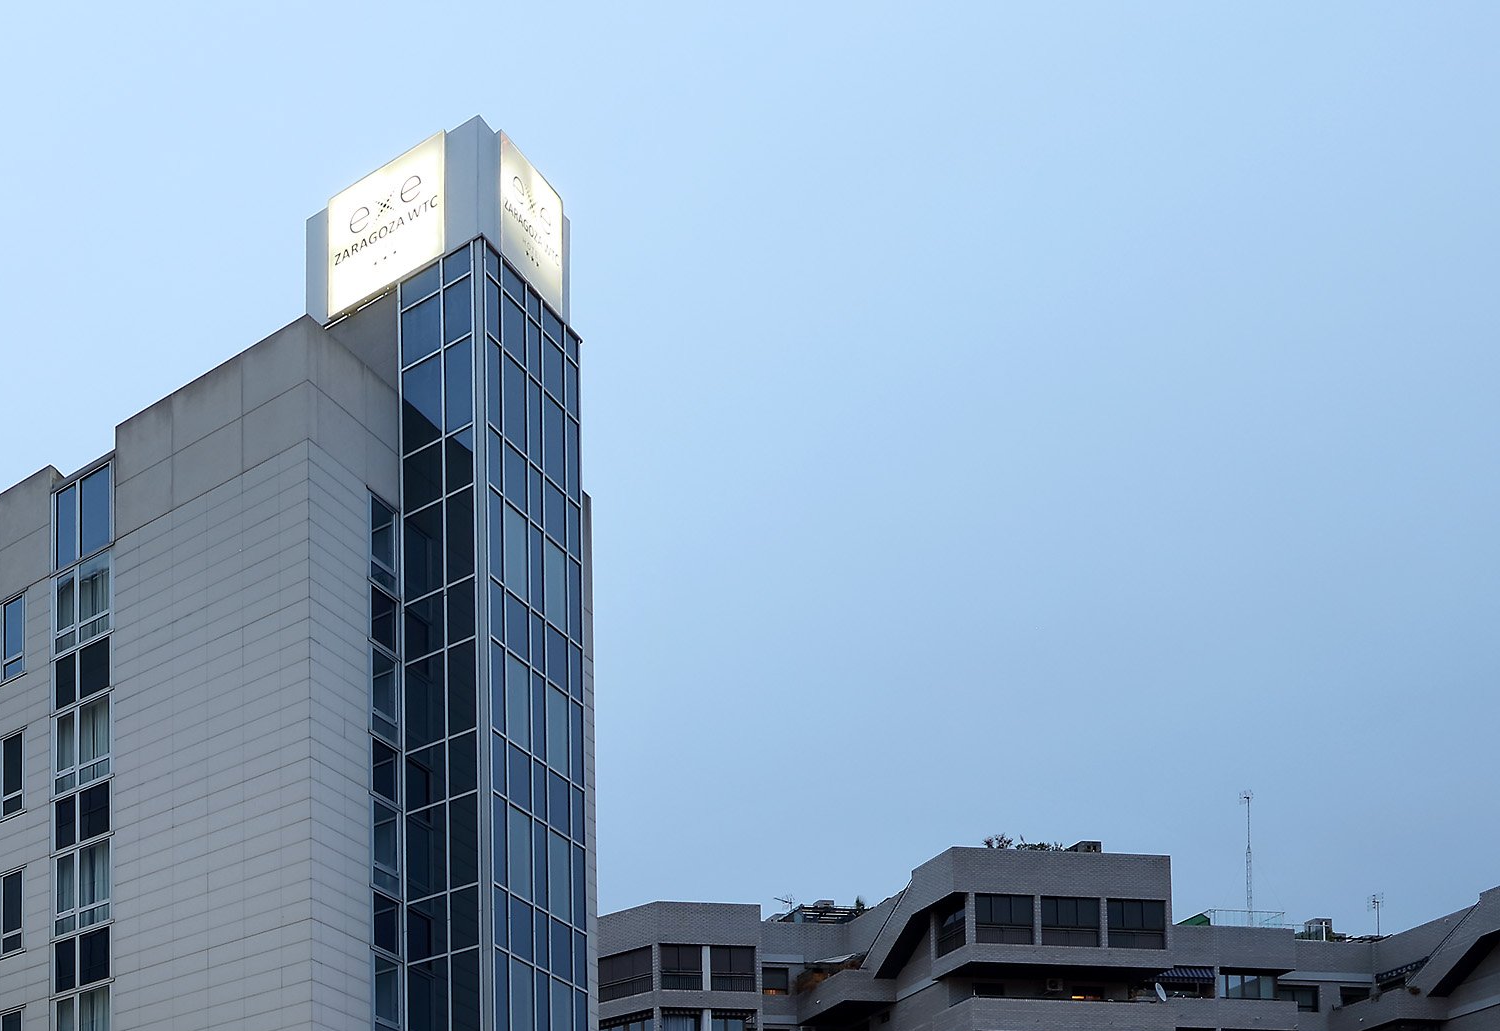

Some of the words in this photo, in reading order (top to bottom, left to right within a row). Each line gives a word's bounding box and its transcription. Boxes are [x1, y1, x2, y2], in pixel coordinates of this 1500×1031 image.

[334, 216, 405, 266] ZARAGOZA
[407, 194, 438, 221] WTC
[349, 175, 422, 234] exe
